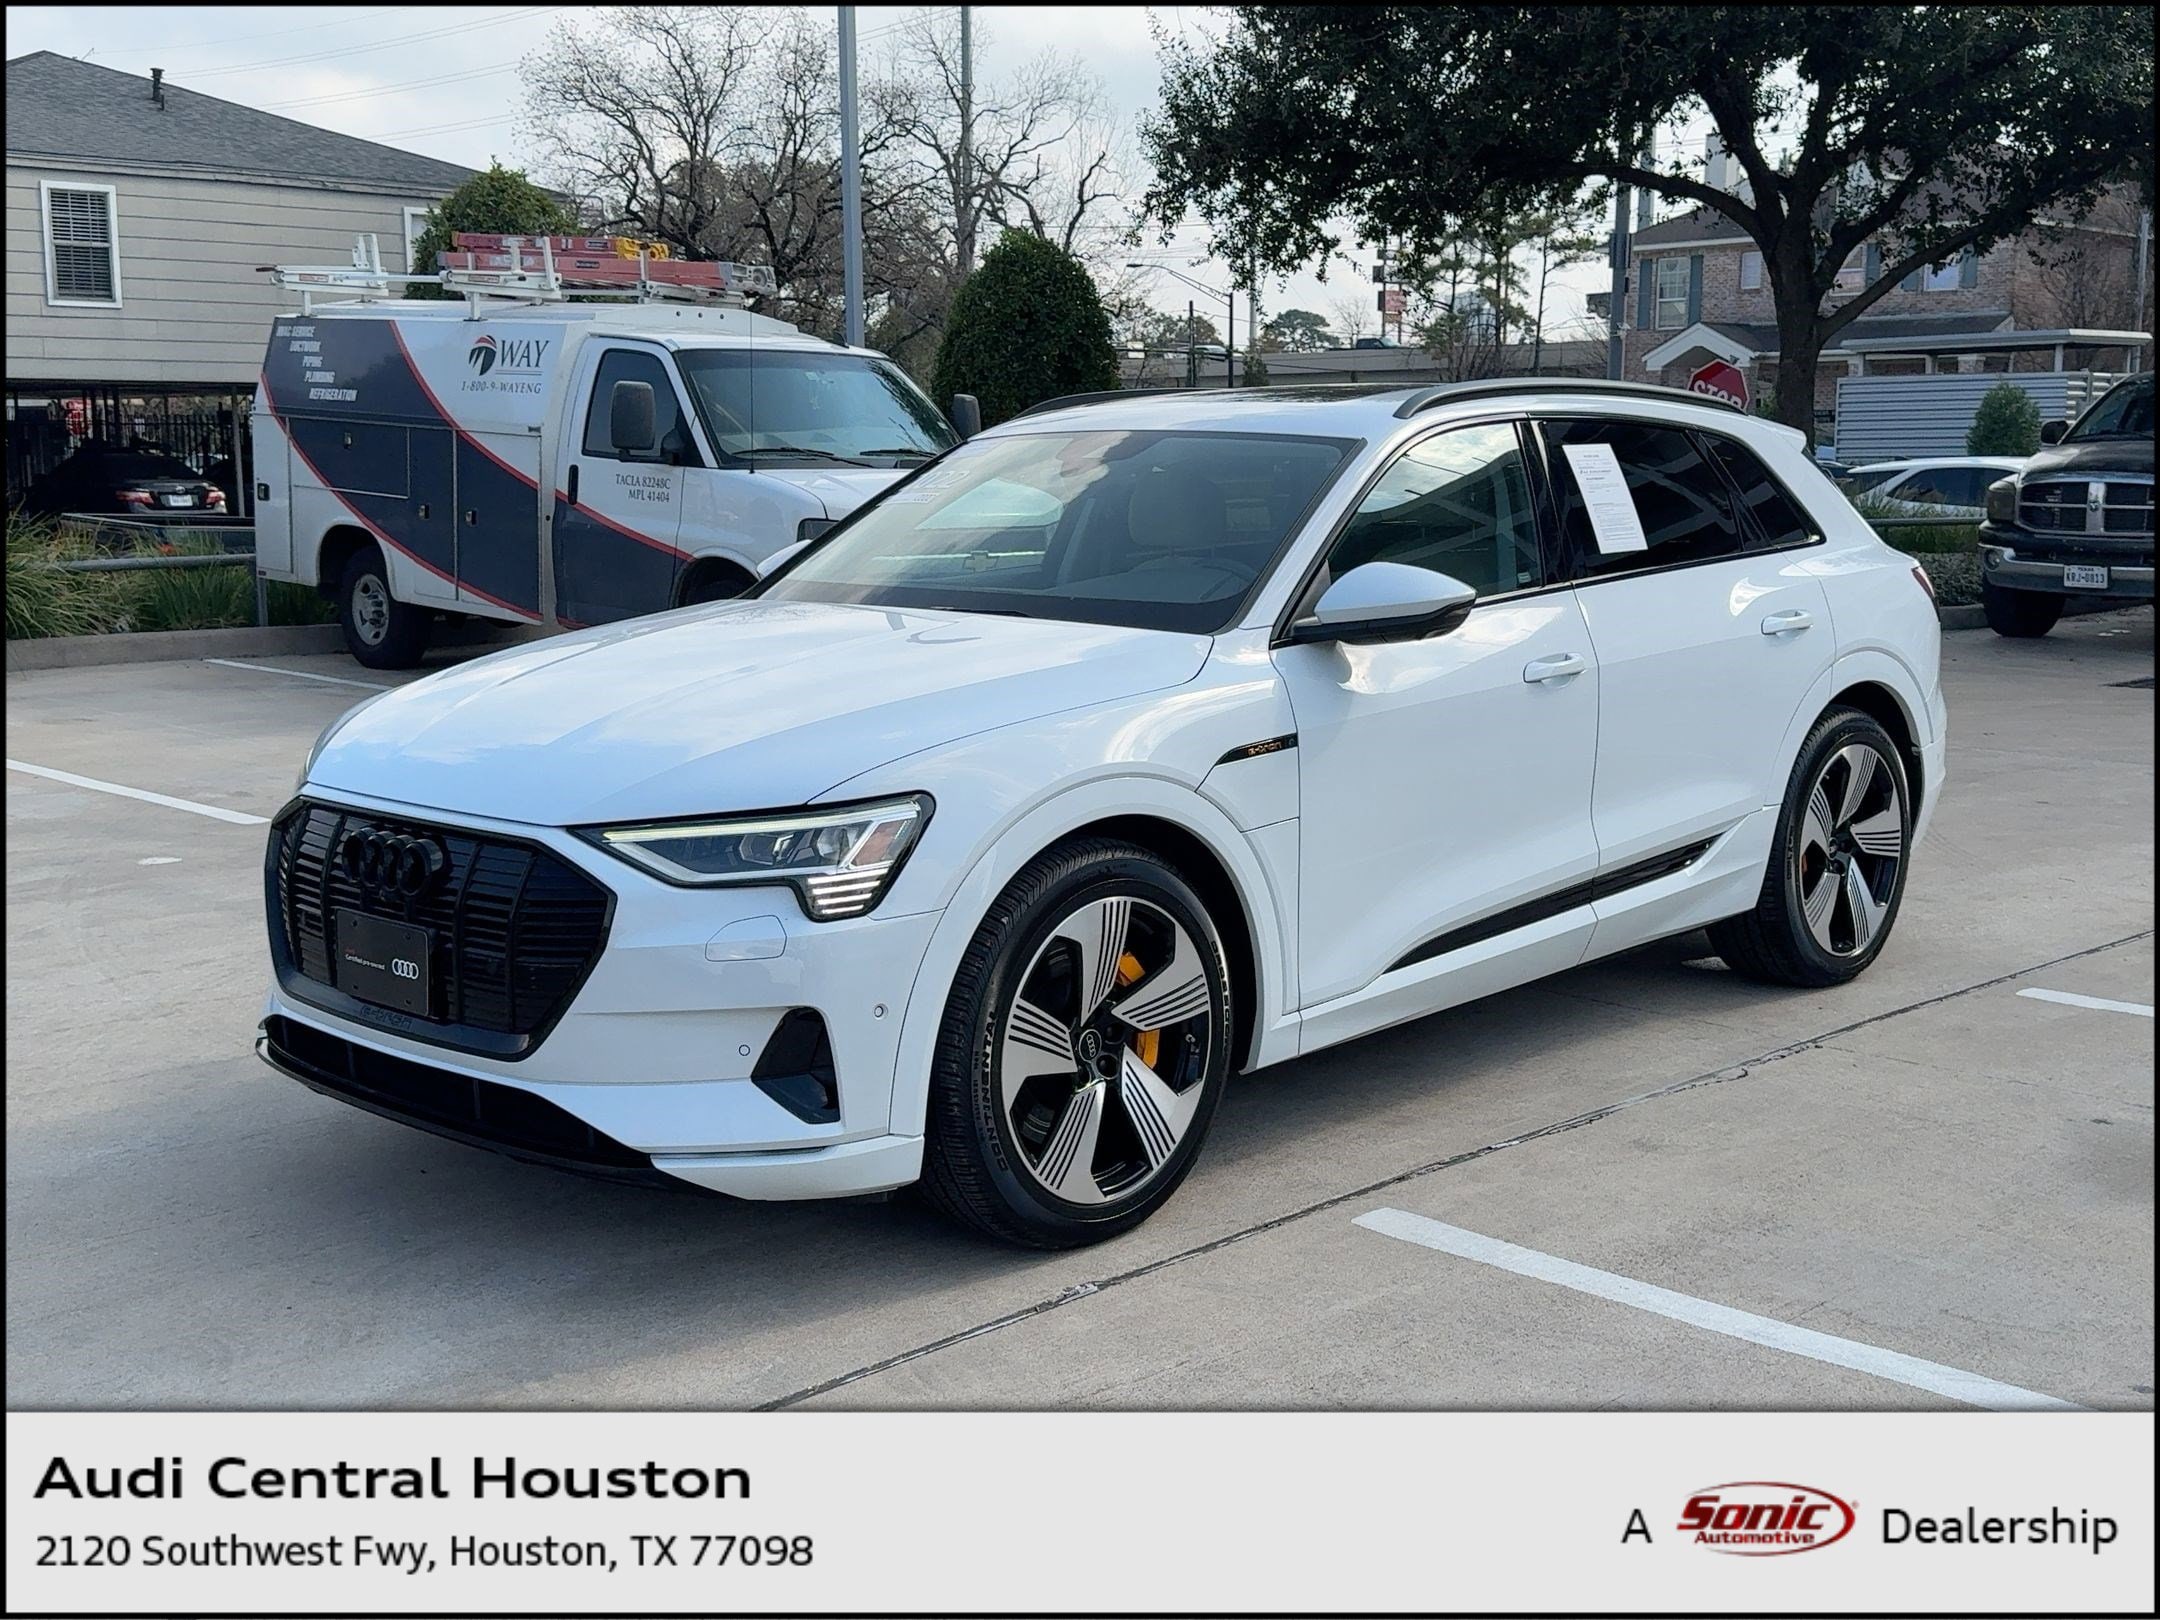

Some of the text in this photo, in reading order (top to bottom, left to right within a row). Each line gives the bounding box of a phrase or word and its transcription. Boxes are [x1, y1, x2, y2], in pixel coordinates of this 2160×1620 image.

[500, 340, 550, 368] WAY
[308, 387, 358, 402] REFRIGERATION
[628, 488, 645, 501] MPL
